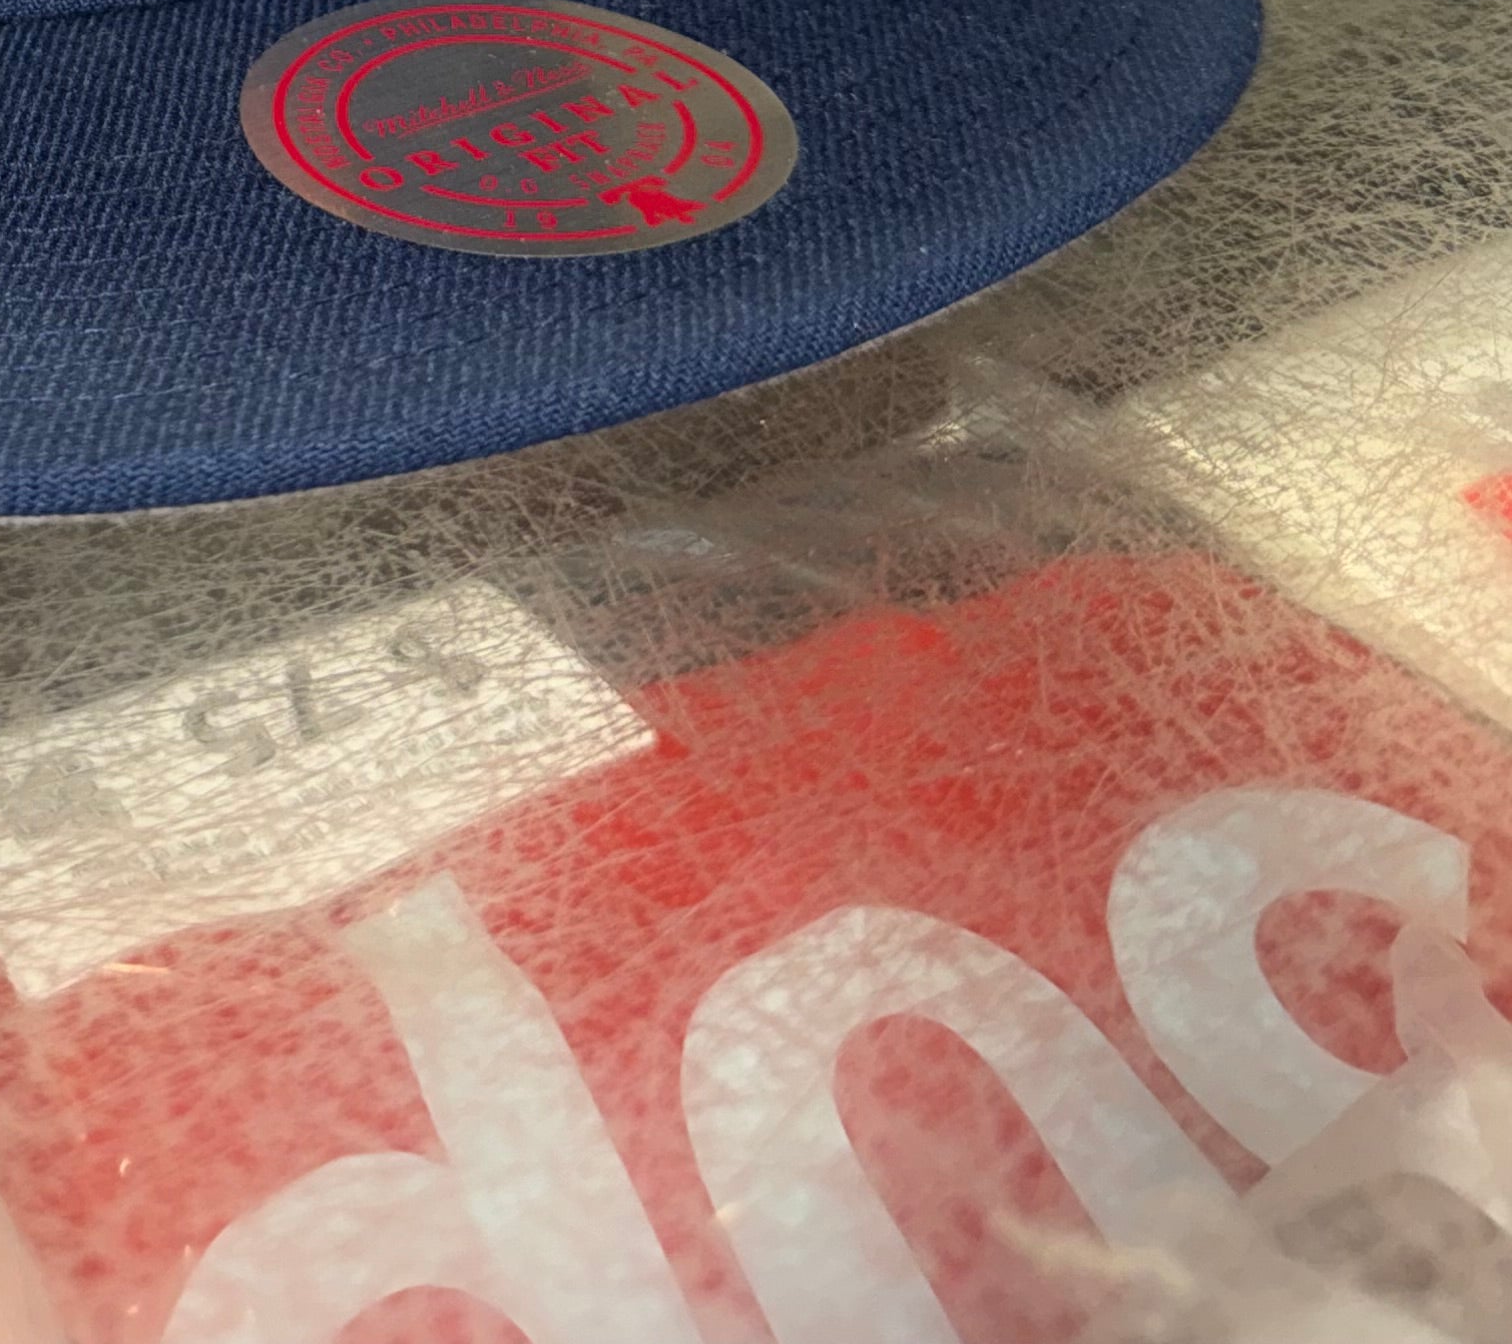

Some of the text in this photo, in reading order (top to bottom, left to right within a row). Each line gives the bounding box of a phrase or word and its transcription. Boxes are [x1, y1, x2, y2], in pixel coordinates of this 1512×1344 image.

[357, 70, 700, 192] ORIGINAL
[361, 83, 493, 140] Mitchell
[491, 79, 515, 96] &
[517, 129, 612, 174] FIT
[504, 210, 558, 231] 19
